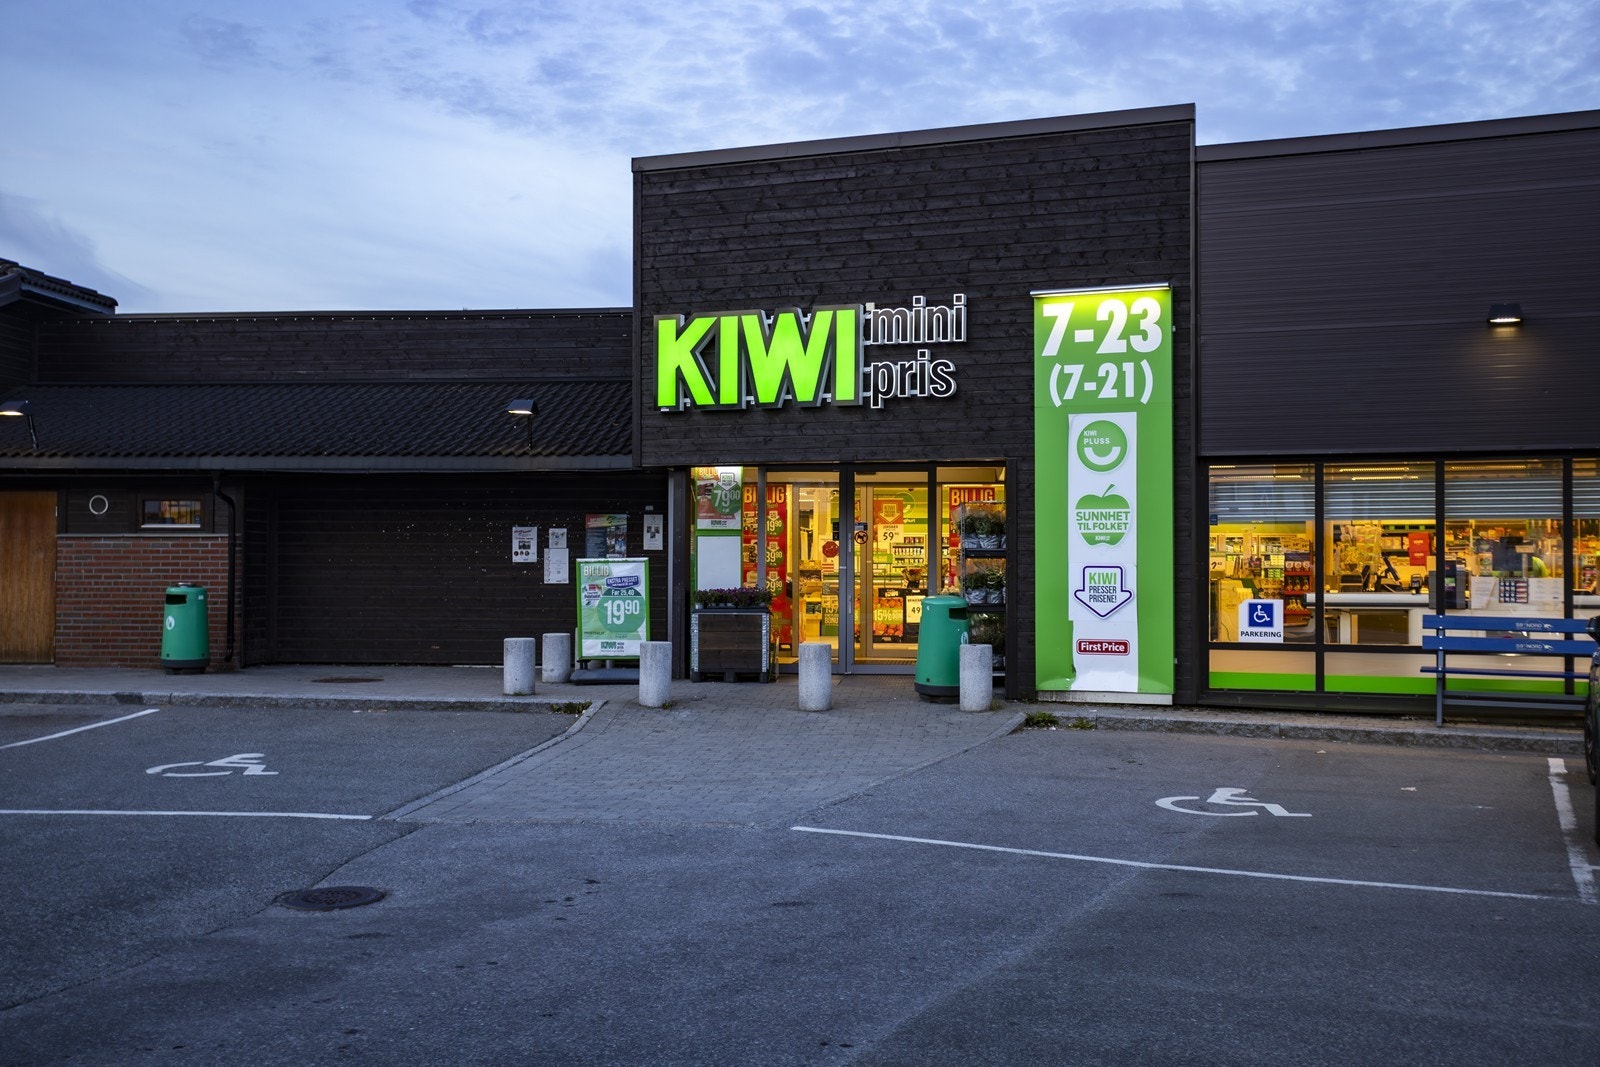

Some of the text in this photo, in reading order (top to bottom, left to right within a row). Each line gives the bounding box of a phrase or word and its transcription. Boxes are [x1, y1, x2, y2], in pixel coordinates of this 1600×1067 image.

[870, 294, 966, 344] mini
[1041, 297, 1162, 357] 7-23
[655, 306, 859, 409] KIWI
[870, 349, 957, 409] pris
[1049, 358, 1154, 408] (7-21)
[1083, 437, 1111, 445] PLUSS
[1075, 511, 1131, 522] SUNNHET
[1088, 572, 1117, 585] KIWI
[1088, 585, 1117, 594] PRESSER
[1088, 595, 1117, 603] PRISENE!
[1240, 630, 1282, 638] PARKERING
[1081, 642, 1125, 652] First Price
